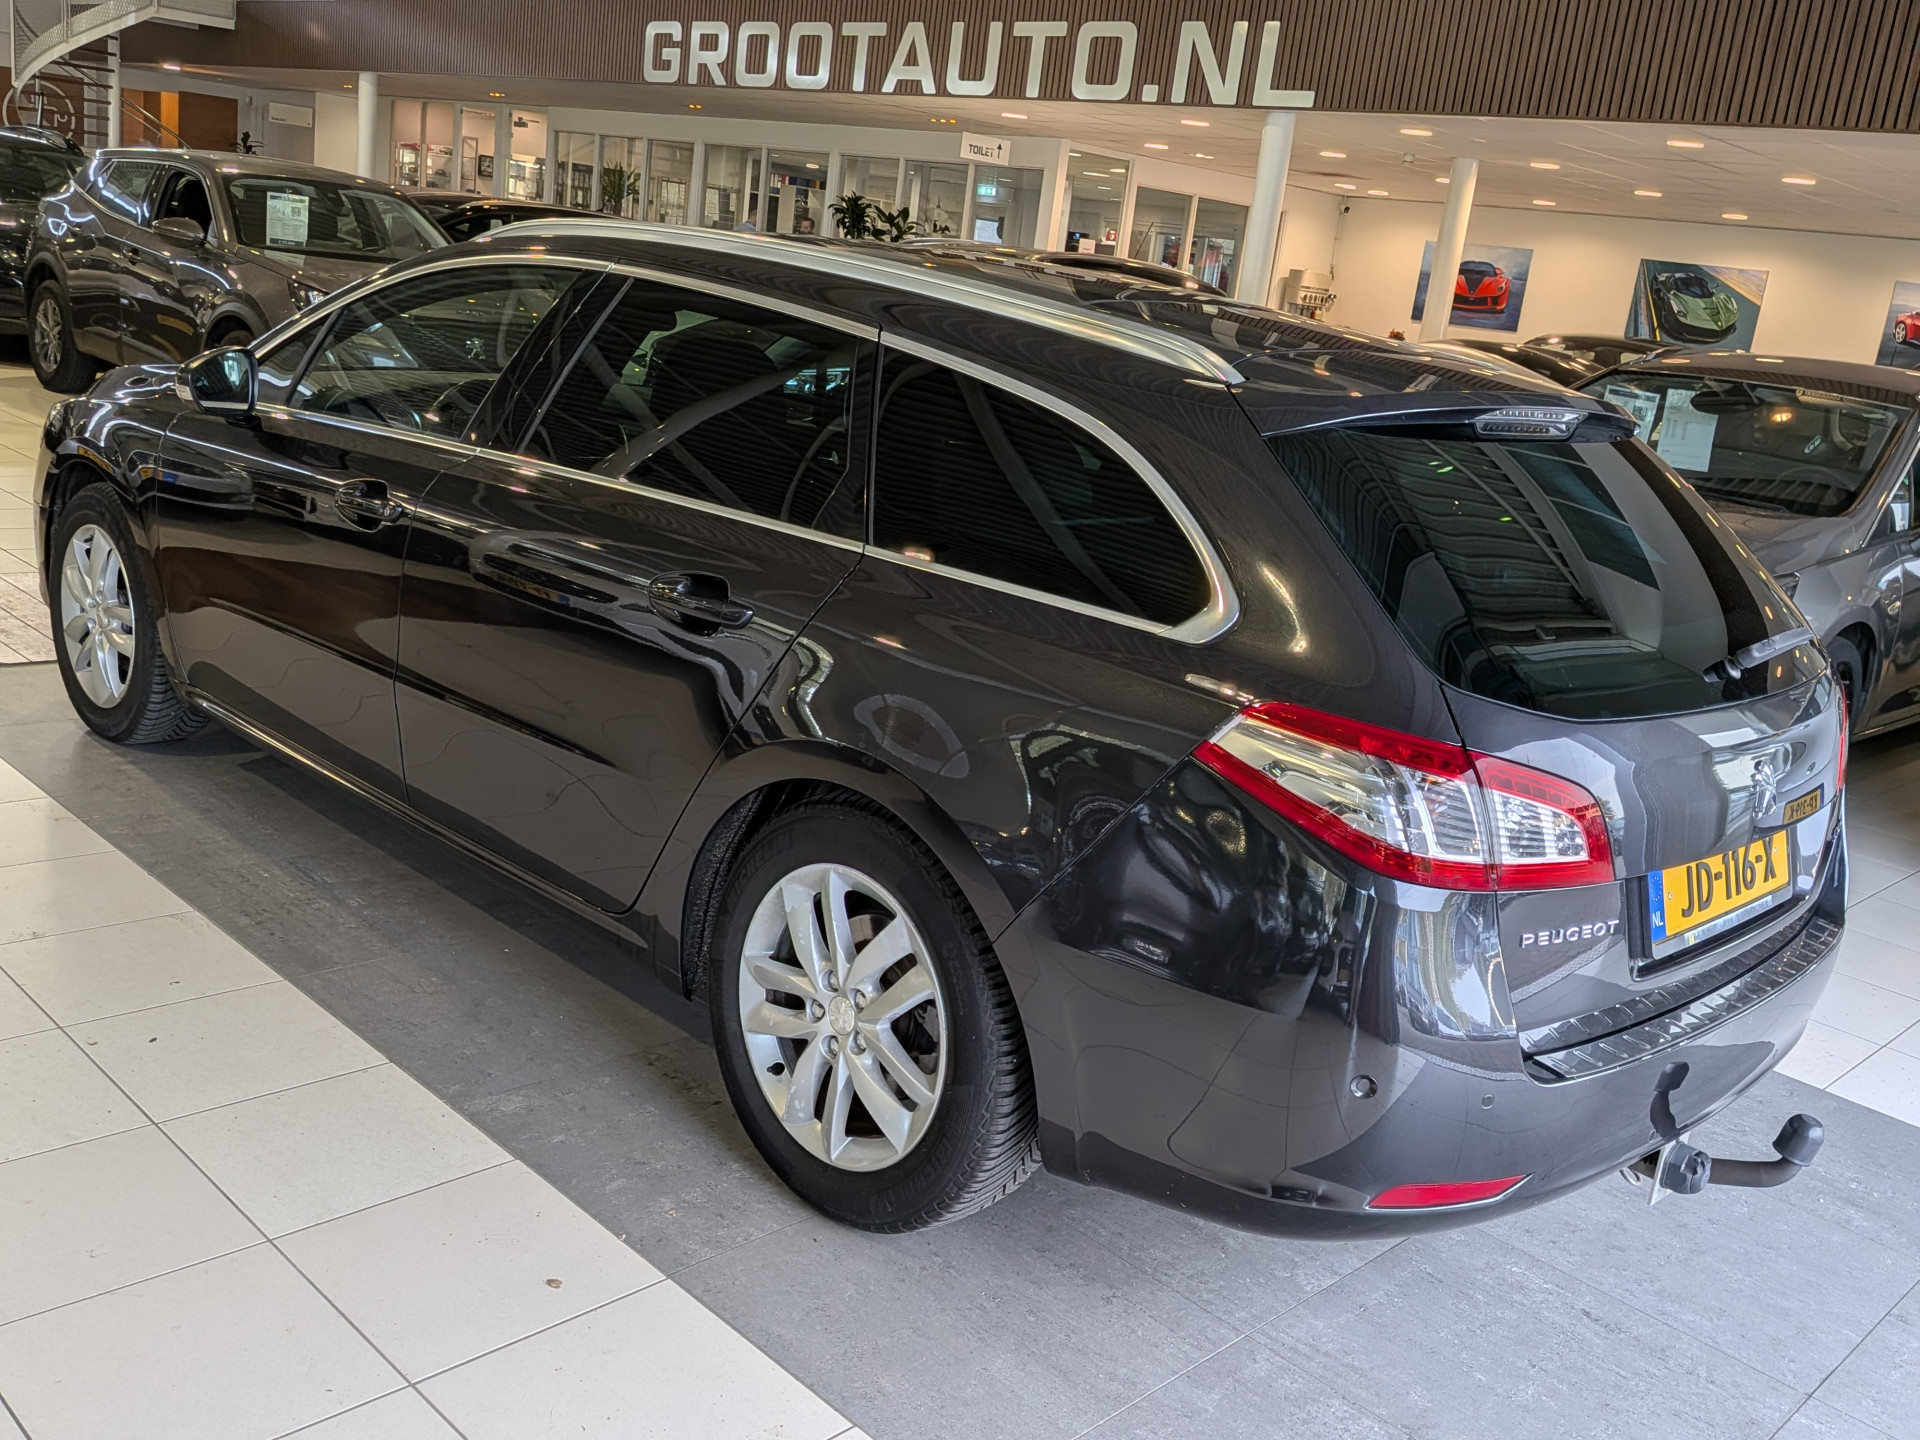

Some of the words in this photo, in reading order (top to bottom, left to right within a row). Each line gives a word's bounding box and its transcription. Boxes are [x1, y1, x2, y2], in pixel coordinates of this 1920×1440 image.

[644, 20, 1315, 107] GROOTAUTO.NL
[968, 143, 995, 158] TOILET
[1682, 837, 1777, 918] JD-116-X
[1520, 919, 1619, 948] PEUGEOT
[1652, 910, 1664, 929] NL
